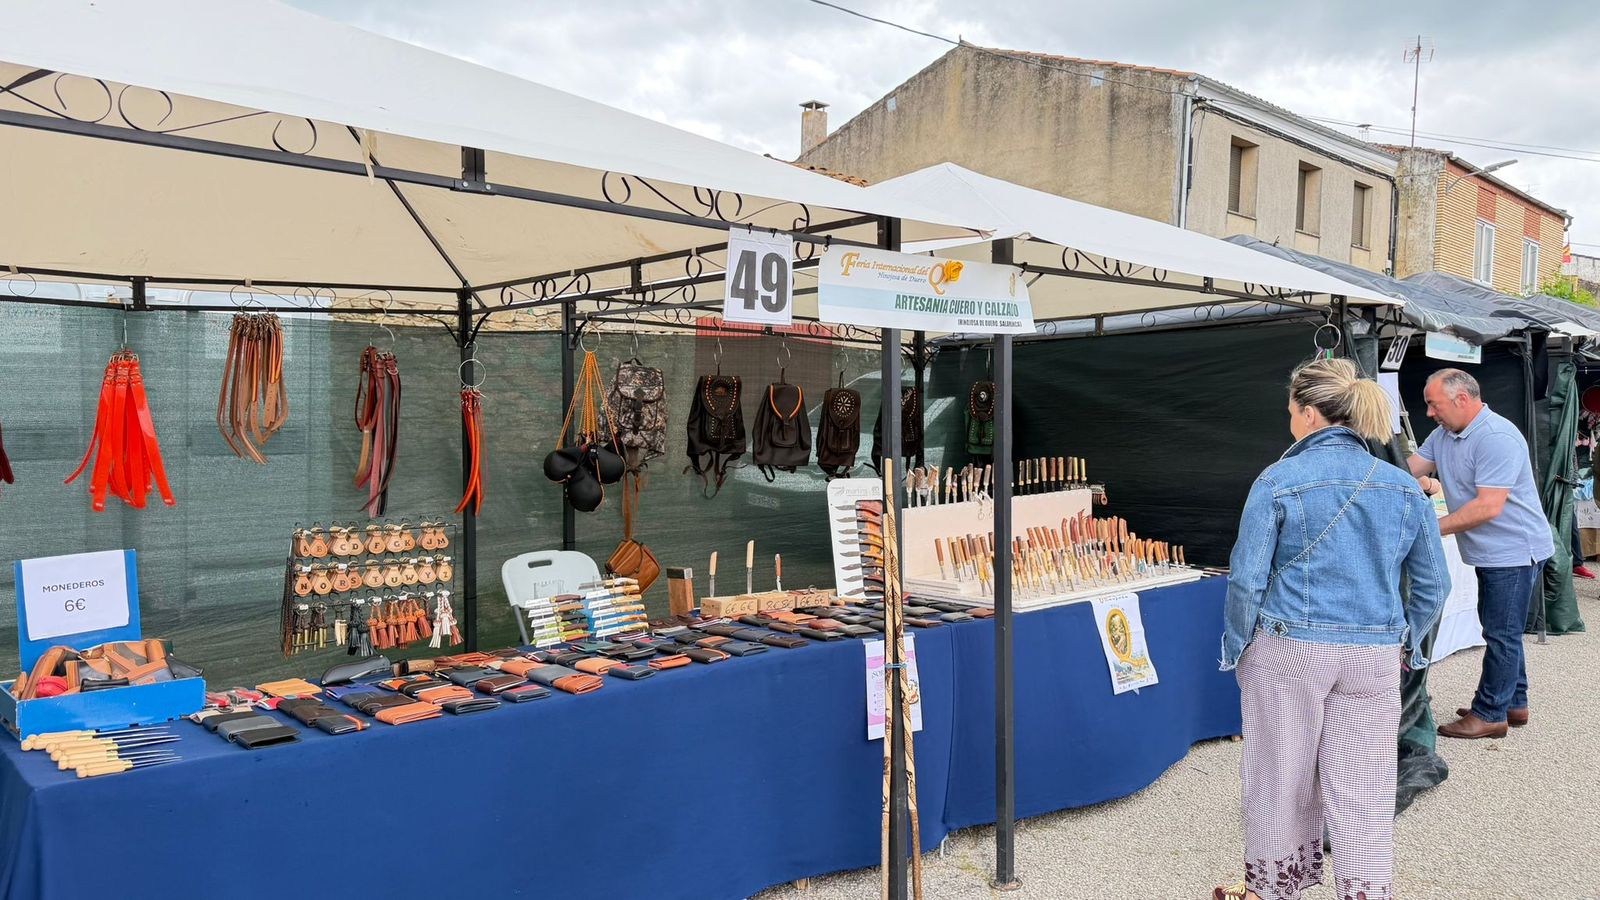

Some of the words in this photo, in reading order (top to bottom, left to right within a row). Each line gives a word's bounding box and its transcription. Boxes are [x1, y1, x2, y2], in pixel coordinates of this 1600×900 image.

[841, 252, 870, 277] Feria
[872, 261, 917, 275] Internacional
[730, 250, 789, 313] 49
[895, 294, 948, 314] ARTESANIA
[949, 299, 976, 315] CUERO
[976, 301, 983, 315] Y
[1387, 335, 1408, 363] 50
[42, 579, 105, 593] MONEDEROS
[64, 598, 86, 612] 6€
